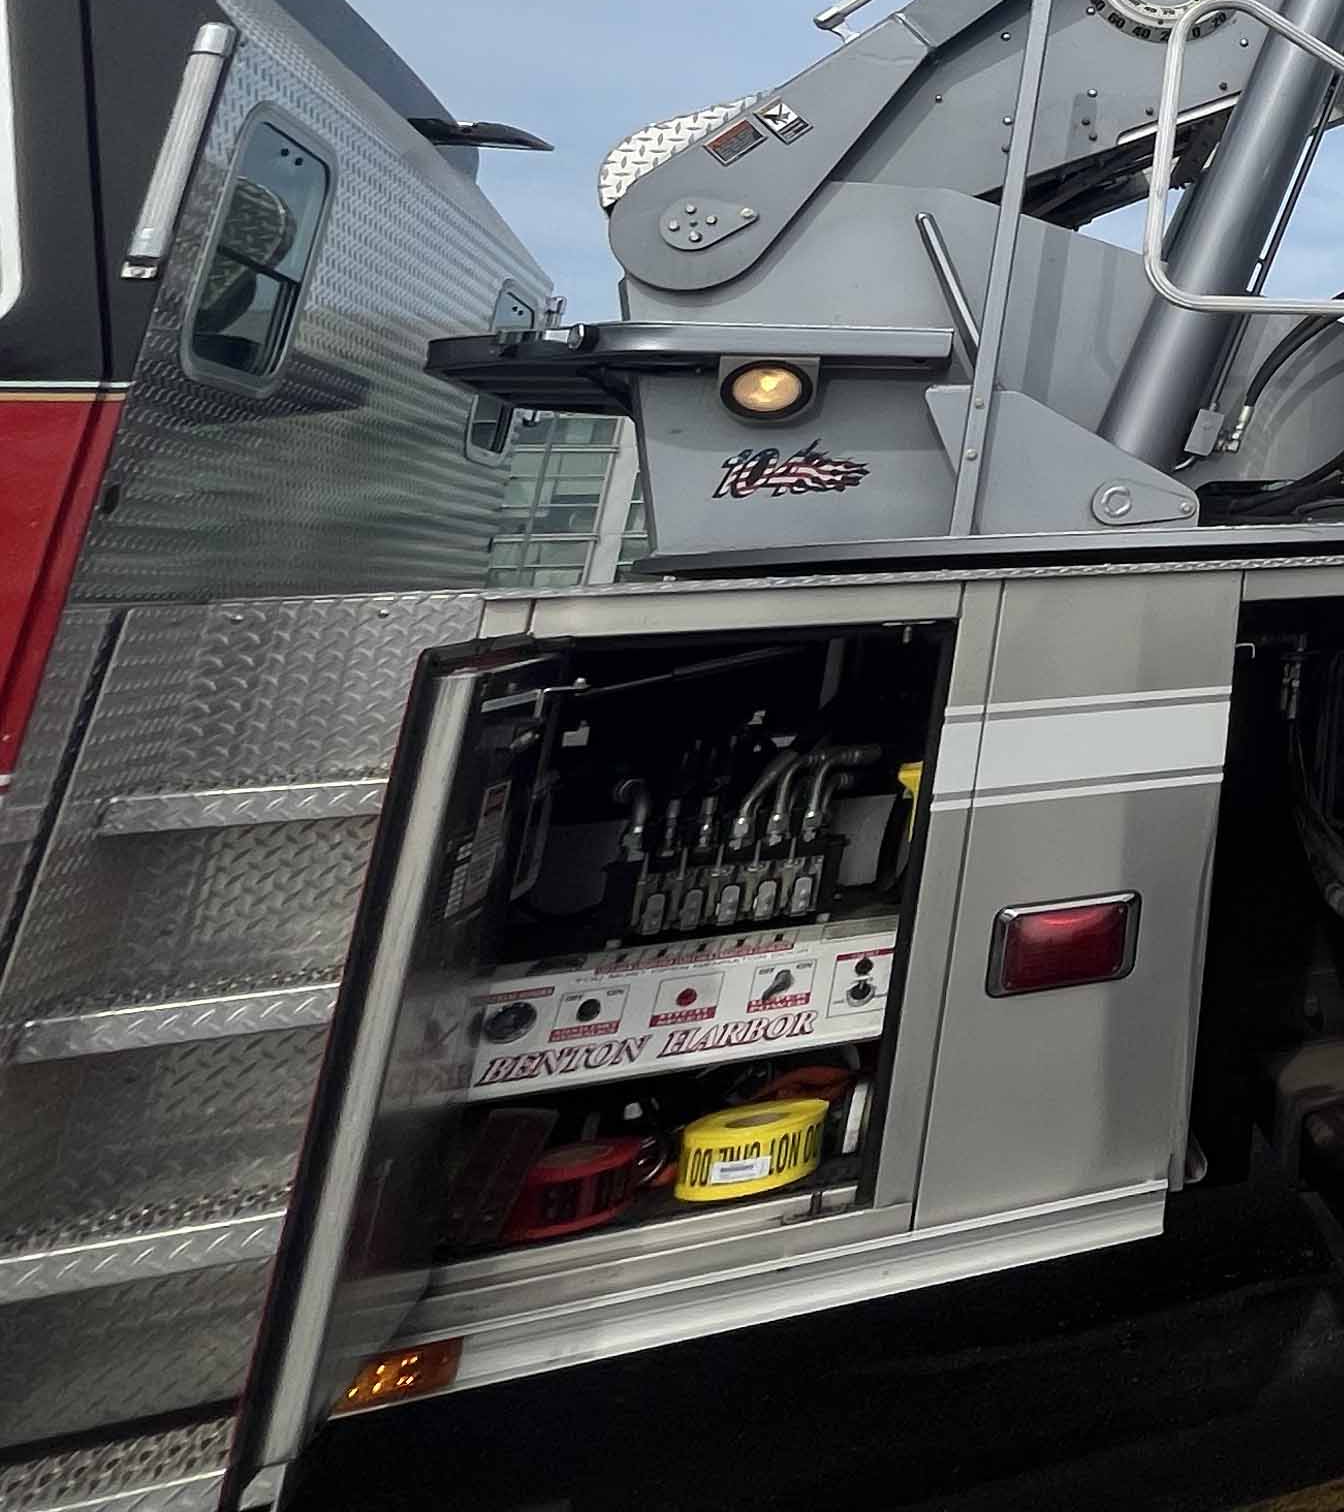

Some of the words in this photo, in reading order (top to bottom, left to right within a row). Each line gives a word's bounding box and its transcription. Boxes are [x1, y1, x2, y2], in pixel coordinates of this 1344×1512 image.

[1108, 12, 1126, 29] 60
[1132, 26, 1150, 39] 40
[474, 1035, 652, 1086] BENTON
[656, 1010, 817, 1059] HARBOR
